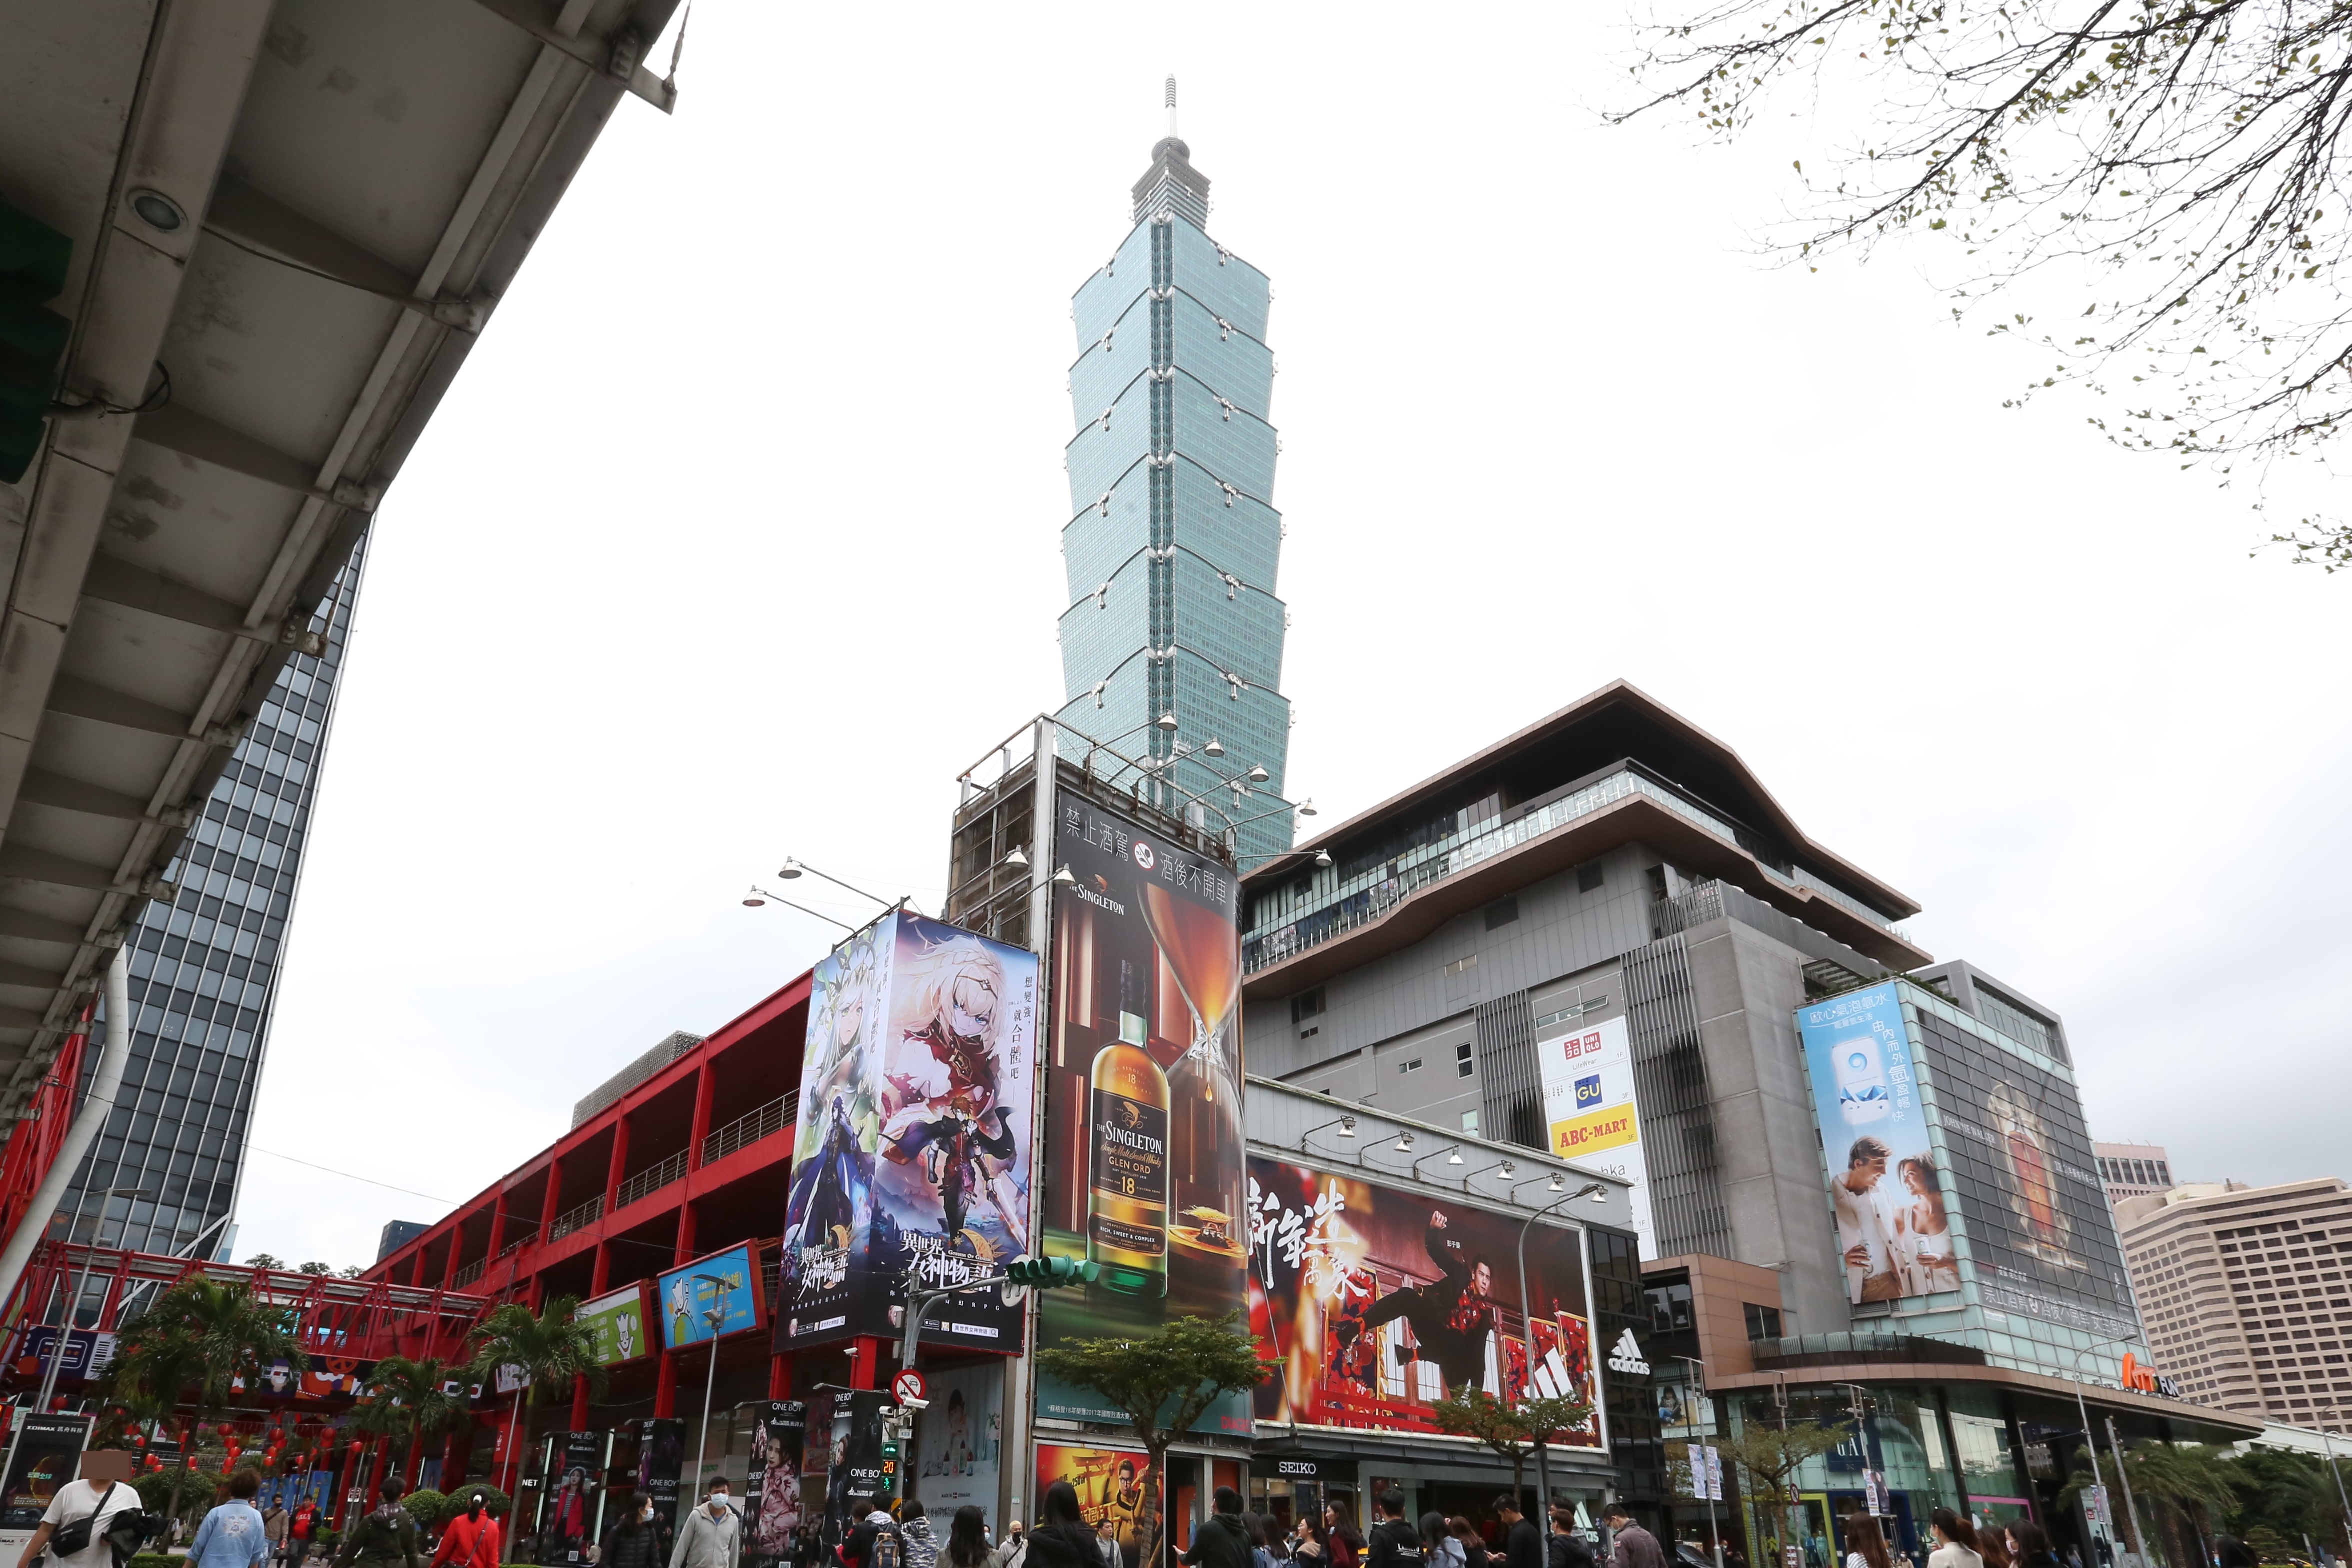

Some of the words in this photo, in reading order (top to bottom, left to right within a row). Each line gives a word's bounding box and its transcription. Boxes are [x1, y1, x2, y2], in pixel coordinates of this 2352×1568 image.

[1066, 806, 1128, 862] 禁止酒駕
[1160, 852, 1226, 906] 酒後不開車
[1078, 883, 1125, 916] SINGLETON
[1010, 1009, 1023, 1080] 就合體吧
[1572, 1058, 1598, 1070] LifeWear
[1128, 1074, 1136, 1084] 18
[1578, 1083, 1600, 1101] GU
[1622, 1092, 1630, 1100] 3F
[1096, 1124, 1106, 1133] THE
[1560, 1118, 1628, 1148] ABC-MART
[1101, 1141, 1117, 1156] Single
[1116, 1145, 1130, 1159] Malt
[1129, 1150, 1146, 1164] Scotch
[1146, 1152, 1162, 1168] Whisky
[1109, 1156, 1130, 1170] GLEN
[1133, 1164, 1150, 1174] ORD
[1120, 1170, 1140, 1178] DISTILLERY
[1122, 1176, 1135, 1194] 18
[1107, 1222, 1128, 1231] PERFECTLY
[900, 1230, 944, 1257] 異世界
[1113, 1230, 1128, 1238] SWEET
[1134, 1235, 1156, 1243] COMPLEX
[799, 1244, 824, 1268] 異世界
[1608, 1357, 1650, 1376] adidas
[836, 1394, 844, 1402] ONE
[844, 1392, 852, 1401] BOY
[772, 1403, 786, 1411] ONE
[1222, 1416, 1250, 1432] DIAGE
[851, 1468, 867, 1478] ONE
[869, 1470, 880, 1478] BO
[884, 1462, 894, 1474] 20
[1279, 1462, 1316, 1474] SEIKO
